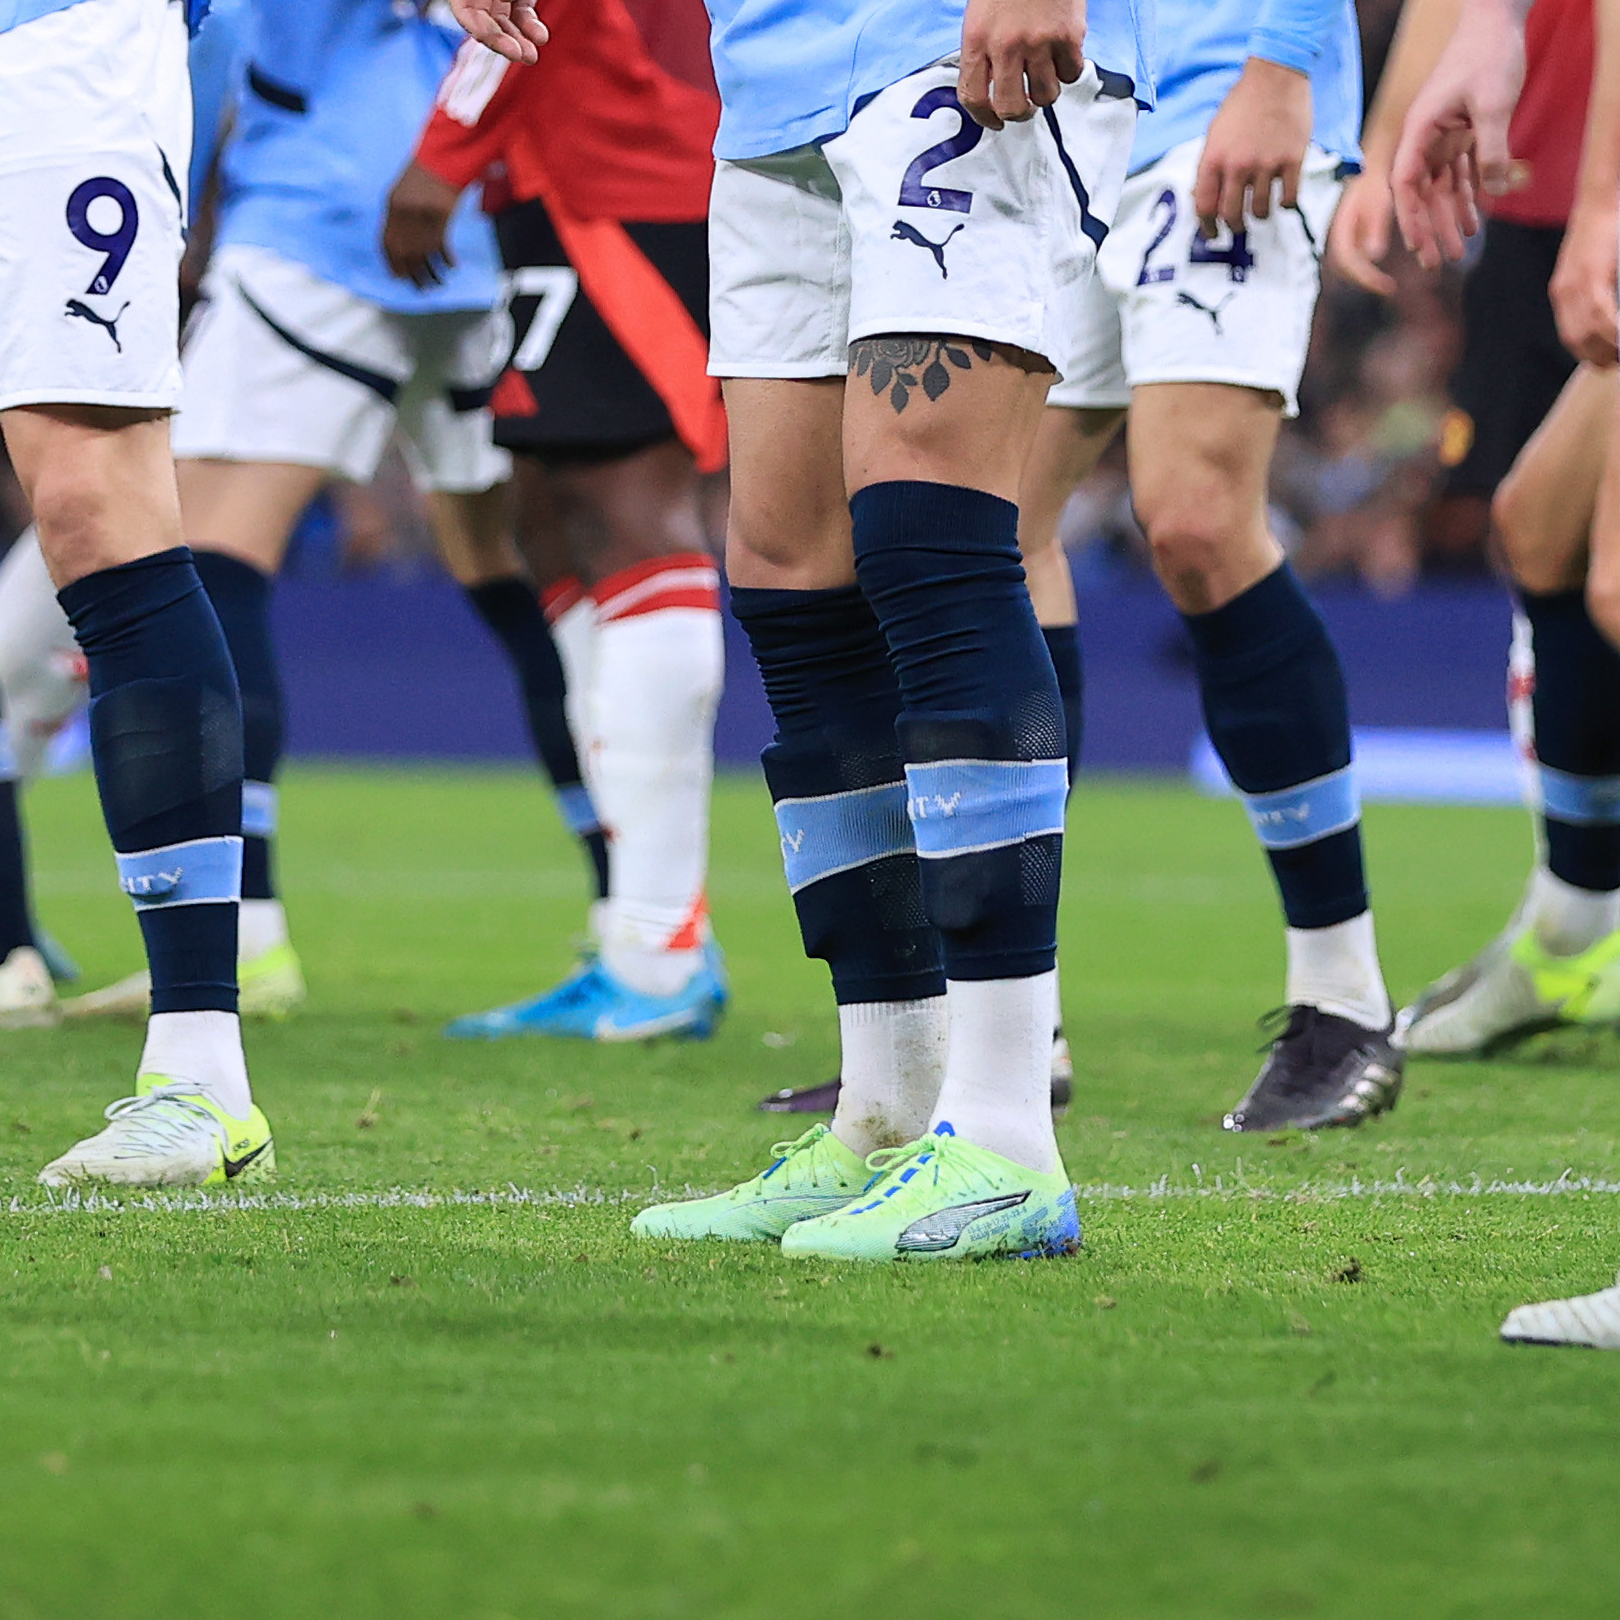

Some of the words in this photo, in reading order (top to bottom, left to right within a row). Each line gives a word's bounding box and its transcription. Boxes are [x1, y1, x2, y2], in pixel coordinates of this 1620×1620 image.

[897, 86, 984, 214] 2
[66, 176, 139, 295] 9
[1137, 189, 1253, 286] 24
